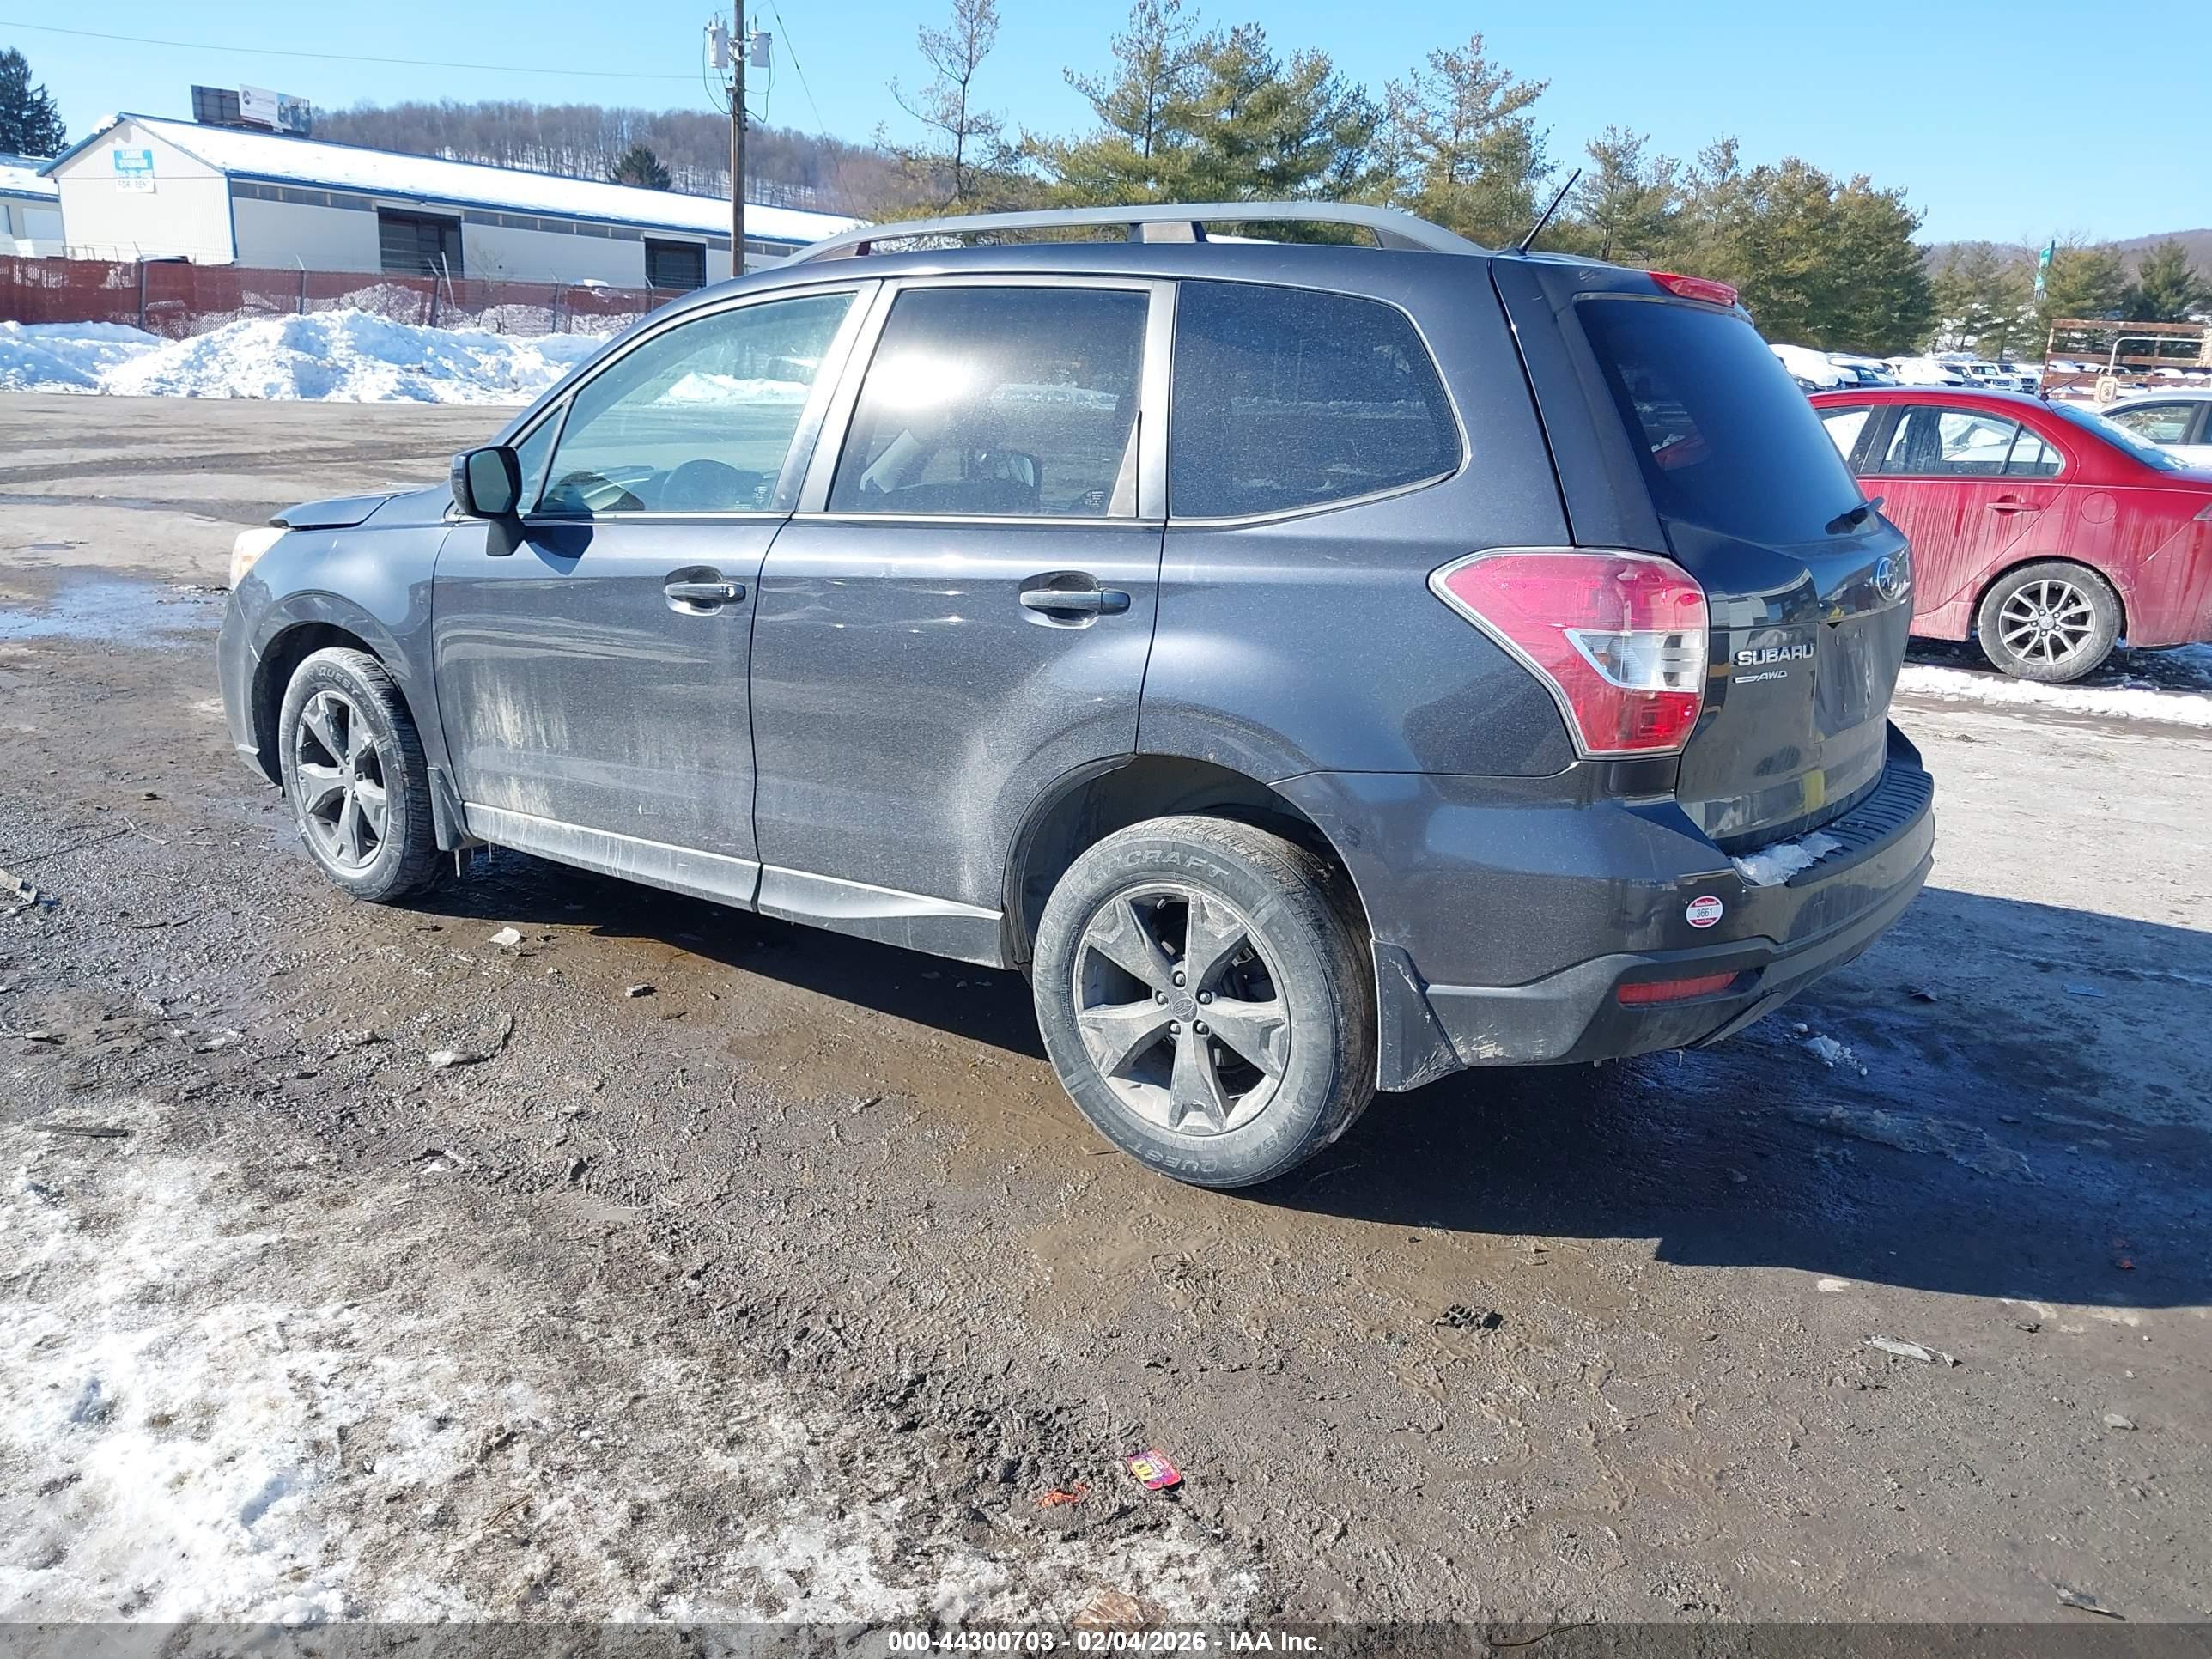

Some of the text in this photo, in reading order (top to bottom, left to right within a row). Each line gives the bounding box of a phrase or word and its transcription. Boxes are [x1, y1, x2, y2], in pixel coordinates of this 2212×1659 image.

[1735, 643, 1814, 667] SUBARU
[318, 666, 362, 695] QUEST
[1126, 1142, 1218, 1174] QUEST
